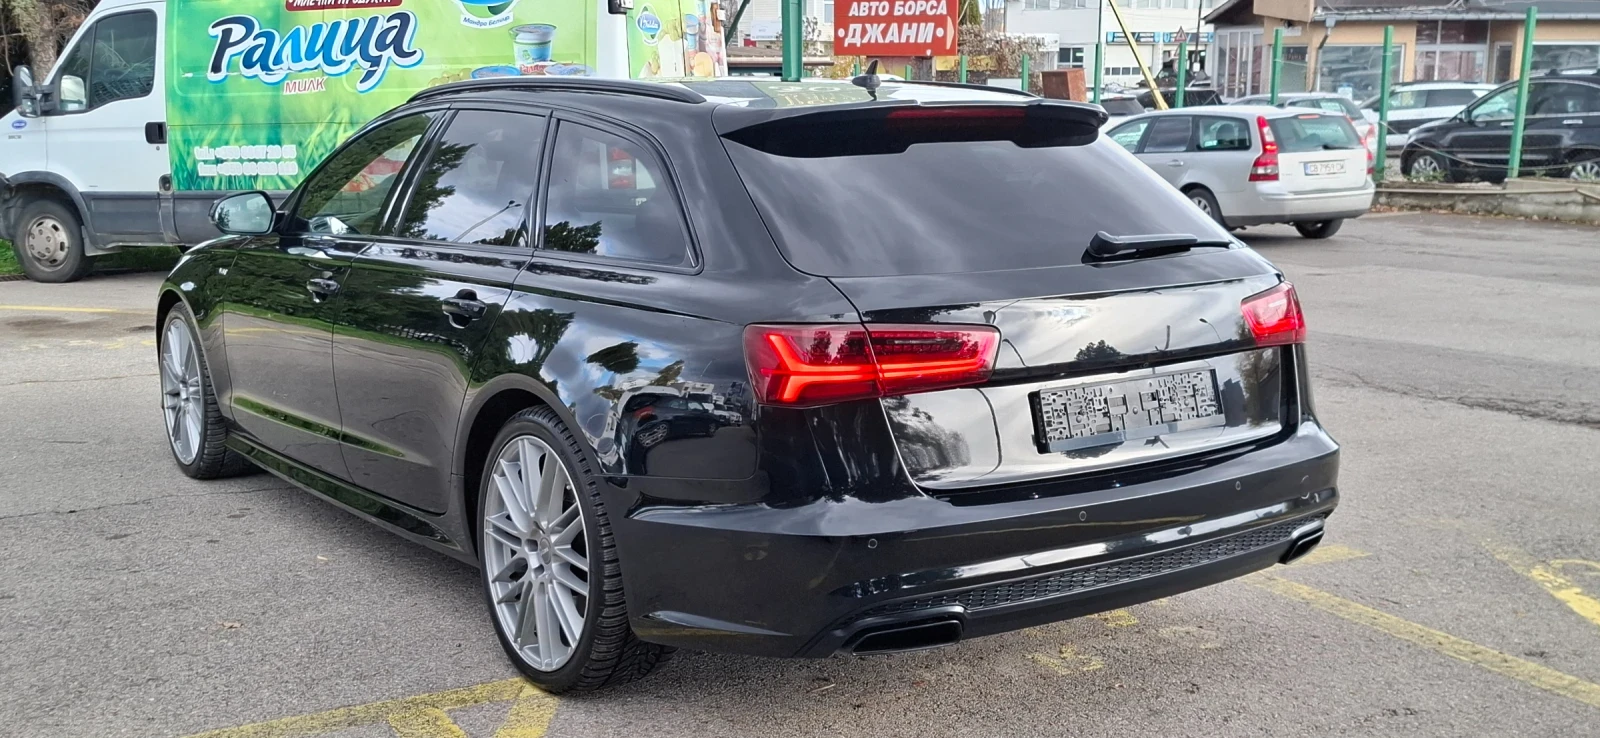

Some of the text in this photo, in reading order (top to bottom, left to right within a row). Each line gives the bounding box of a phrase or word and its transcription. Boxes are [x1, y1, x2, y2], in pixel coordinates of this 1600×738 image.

[848, 0, 947, 17] АВТО БОРСА
[843, 22, 935, 48] ДЖАНИ
[209, 11, 420, 86] Ралица
[284, 77, 326, 94] МИЛК
